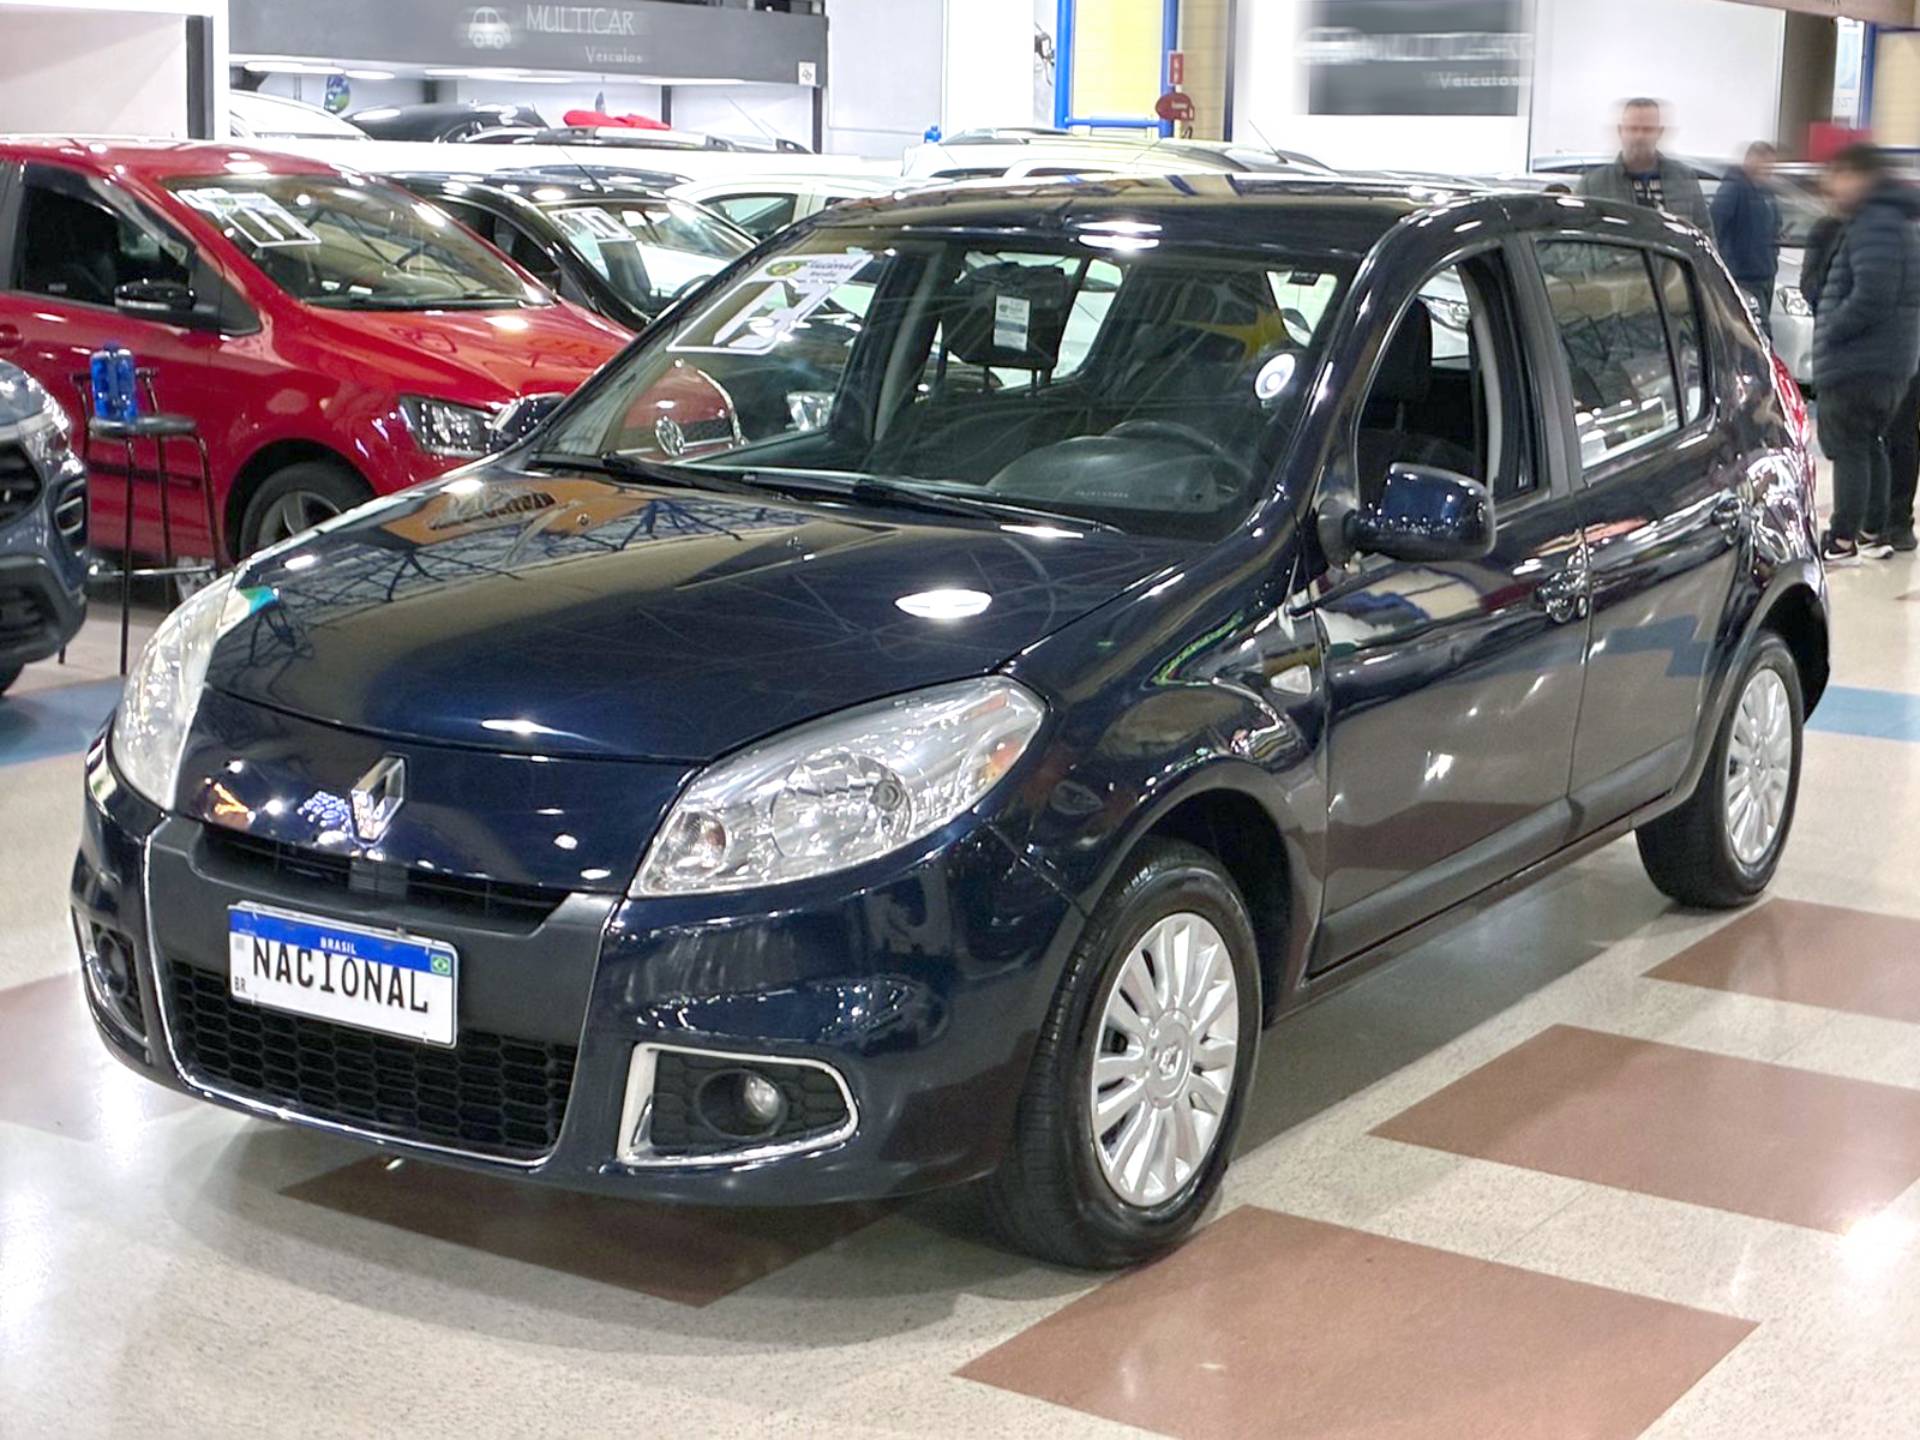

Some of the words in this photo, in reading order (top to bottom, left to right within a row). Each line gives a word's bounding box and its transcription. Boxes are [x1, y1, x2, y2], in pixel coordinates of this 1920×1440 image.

[526, 5, 635, 35] MULTICAR
[320, 936, 357, 954] BRASIL
[253, 936, 429, 1013] NACIONAL
